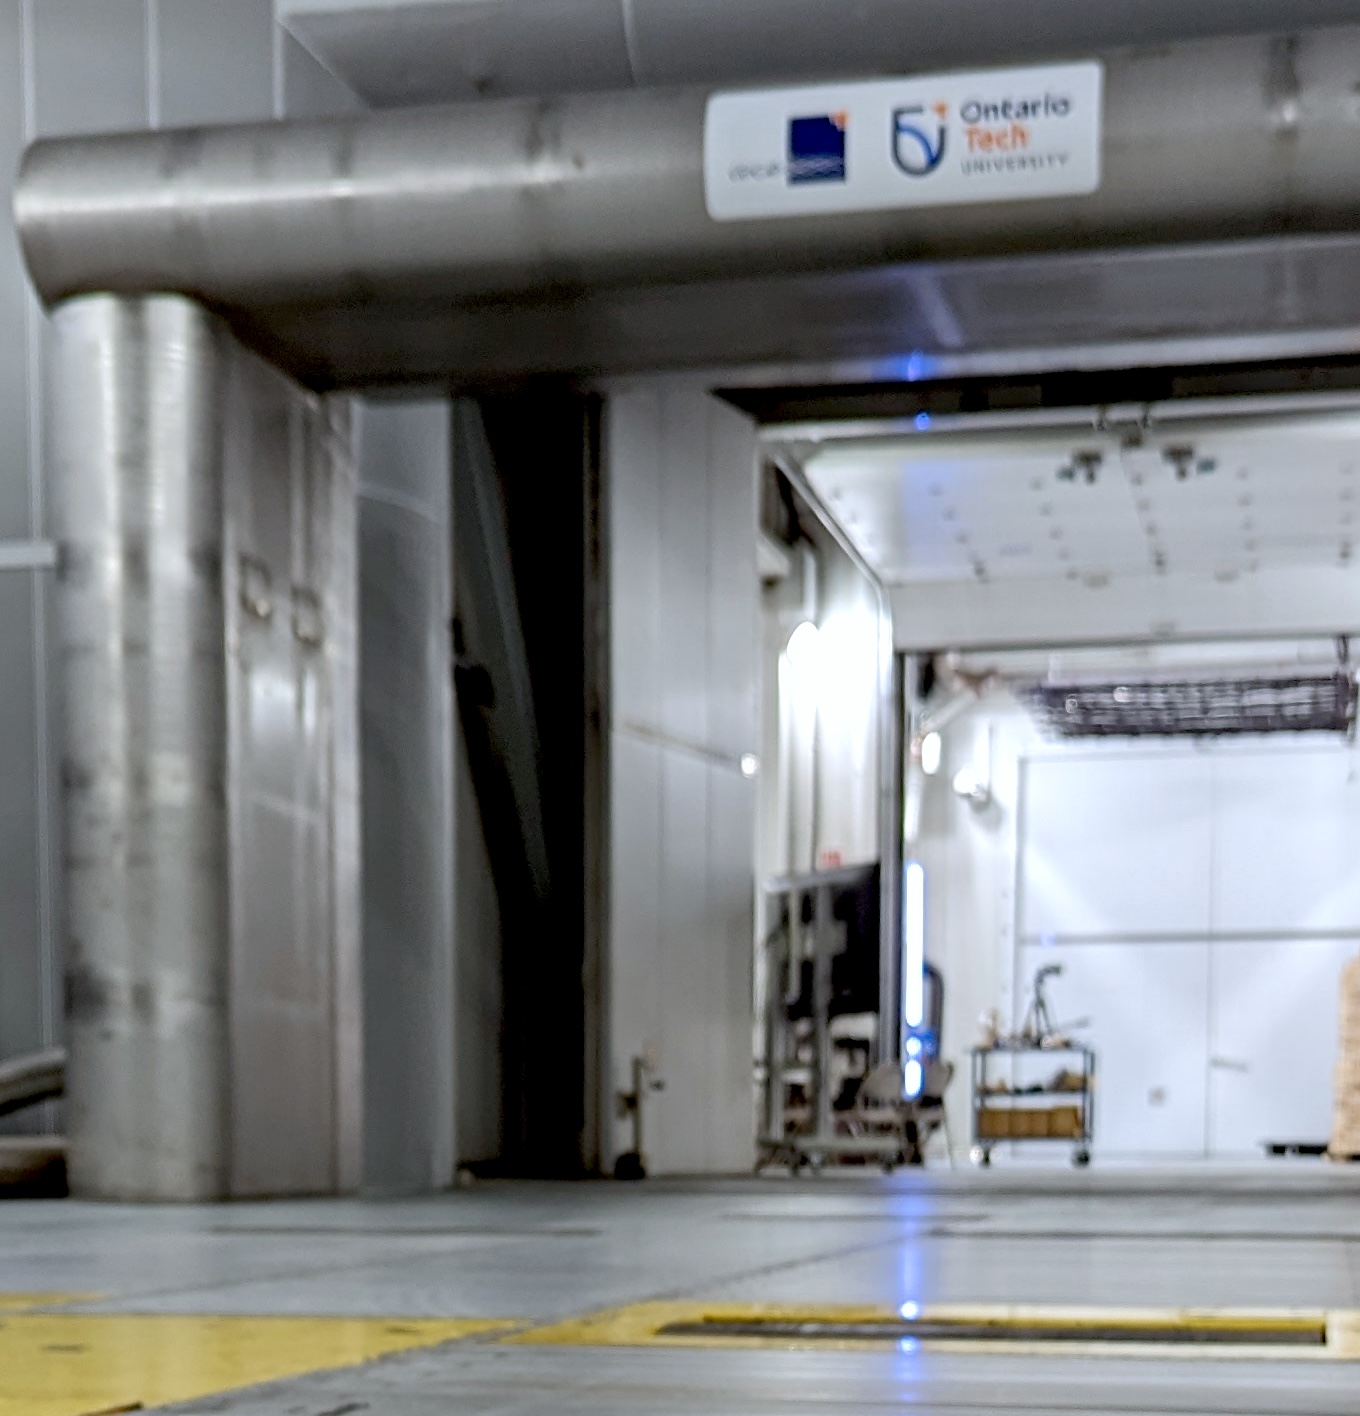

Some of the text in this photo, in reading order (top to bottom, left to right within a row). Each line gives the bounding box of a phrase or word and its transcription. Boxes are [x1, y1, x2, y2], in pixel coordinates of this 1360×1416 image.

[960, 93, 1071, 123] Ontario
[965, 124, 1030, 154] Tech
[960, 154, 1070, 174] UNIVERSITY
